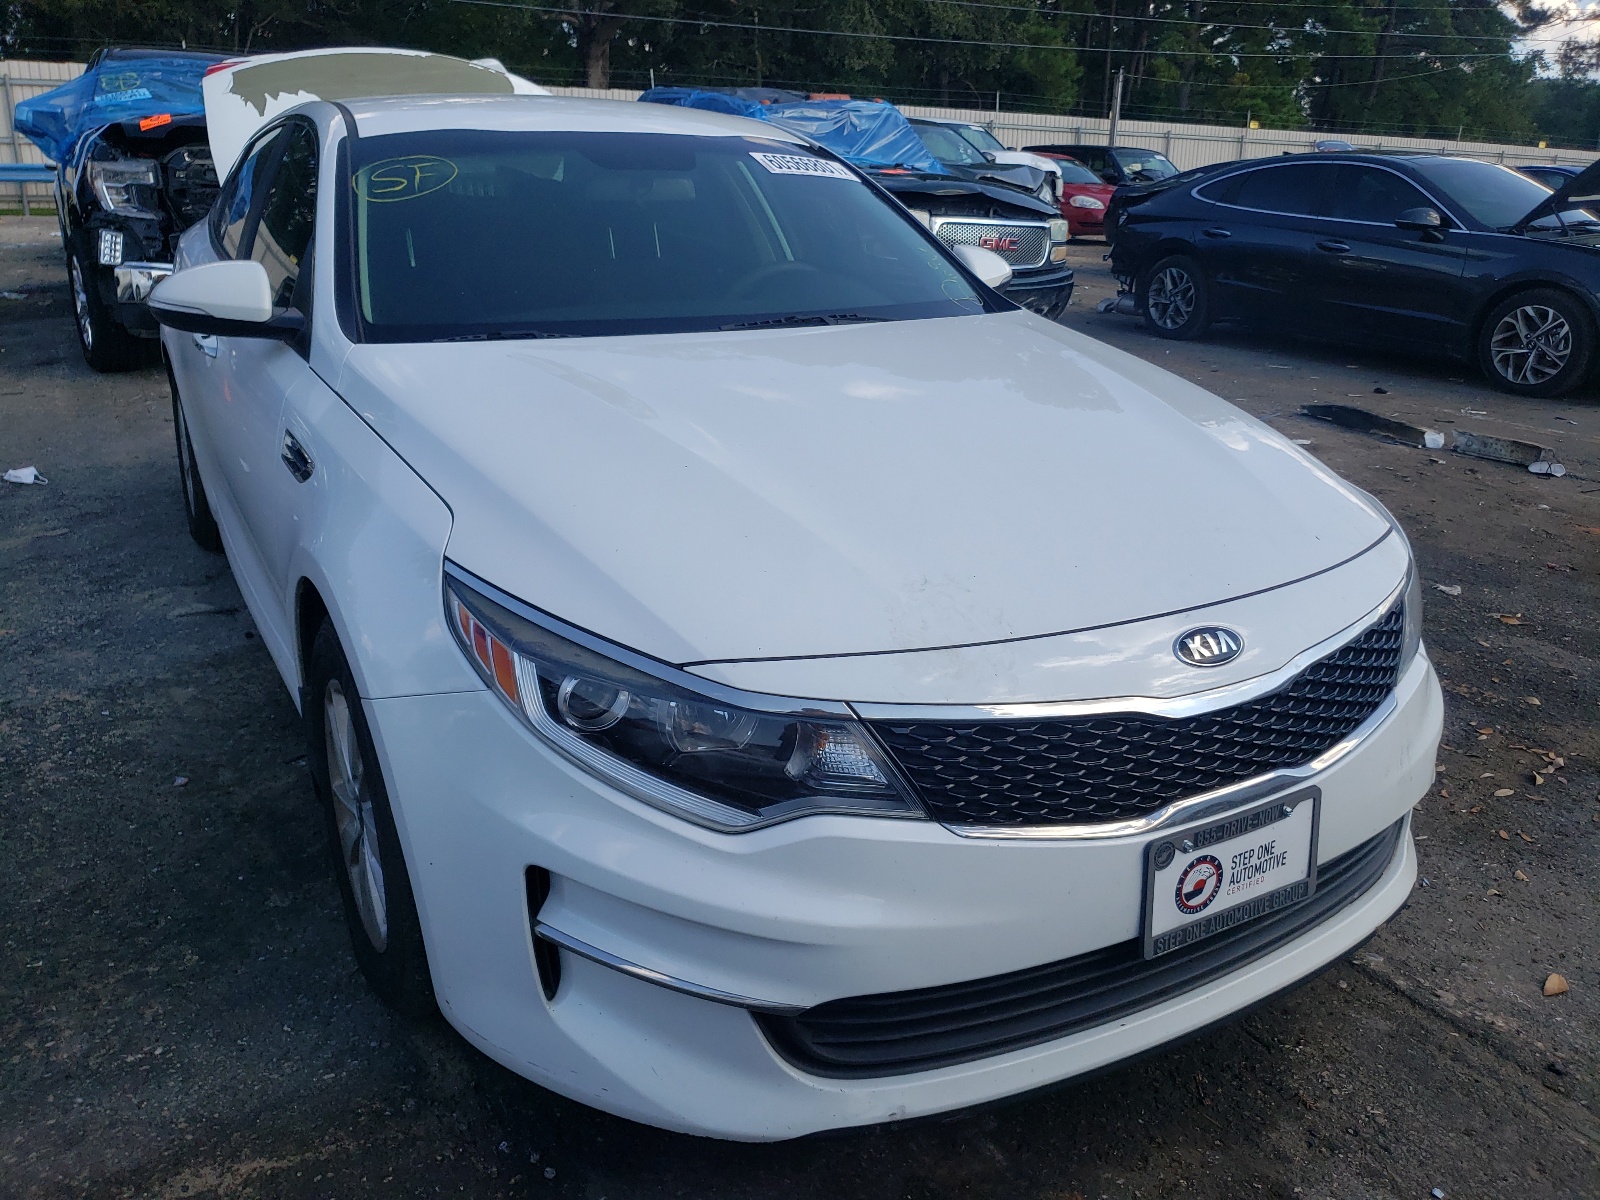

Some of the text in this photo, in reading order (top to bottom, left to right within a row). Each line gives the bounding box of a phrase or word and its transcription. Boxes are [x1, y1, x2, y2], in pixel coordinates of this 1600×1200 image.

[371, 162, 439, 193] SF
[981, 236, 1020, 251] GMC
[1183, 630, 1238, 660] KIA
[1197, 806, 1281, 847] 855-DRIVE-NOW
[1229, 851, 1288, 887] AUTOMOTIVE
[1231, 840, 1276, 870] STEP ONE
[1226, 876, 1265, 896] CERTIFIED
[1157, 883, 1304, 954] STEP ONE AUTOMOTIVE GROUP
